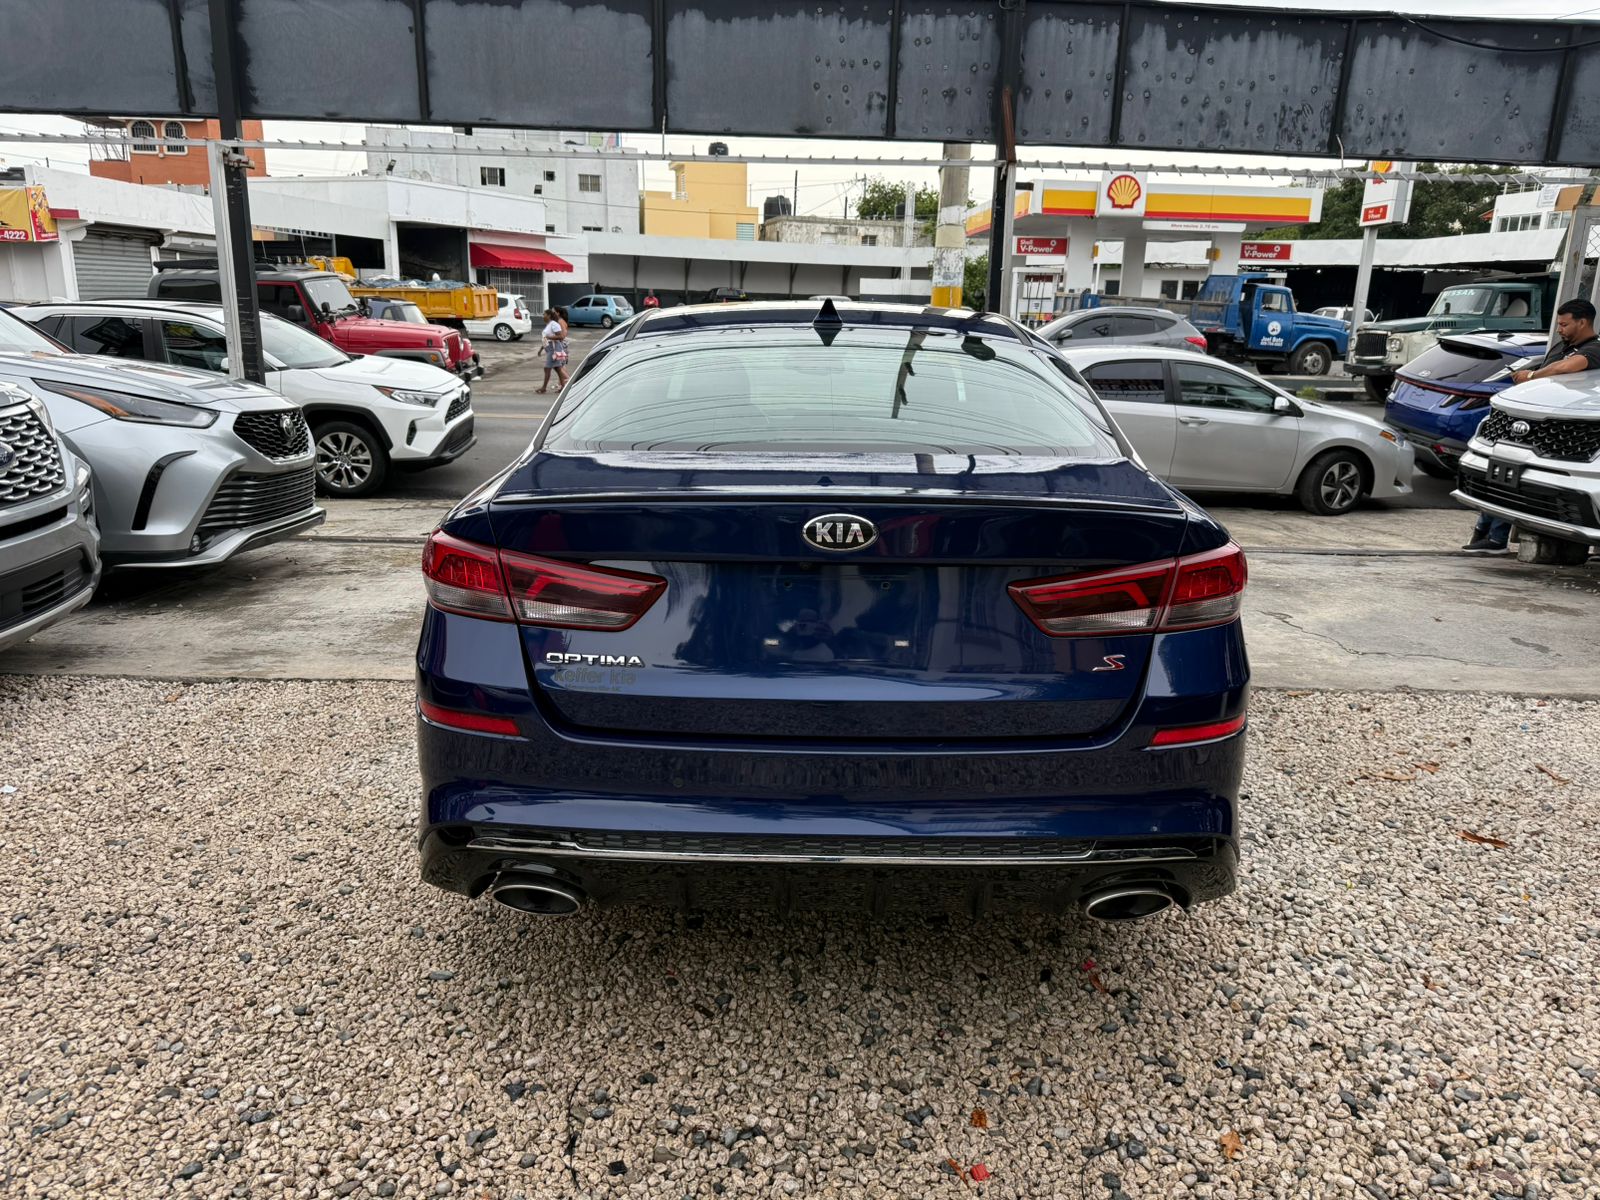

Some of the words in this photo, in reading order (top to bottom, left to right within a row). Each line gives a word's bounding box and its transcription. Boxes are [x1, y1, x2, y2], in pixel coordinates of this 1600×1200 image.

[1020, 245, 1054, 253] V-Power
[1243, 249, 1278, 258] V-Power
[815, 522, 865, 543] KIA
[546, 652, 644, 667] OPTIMA
[1092, 654, 1126, 671] S
